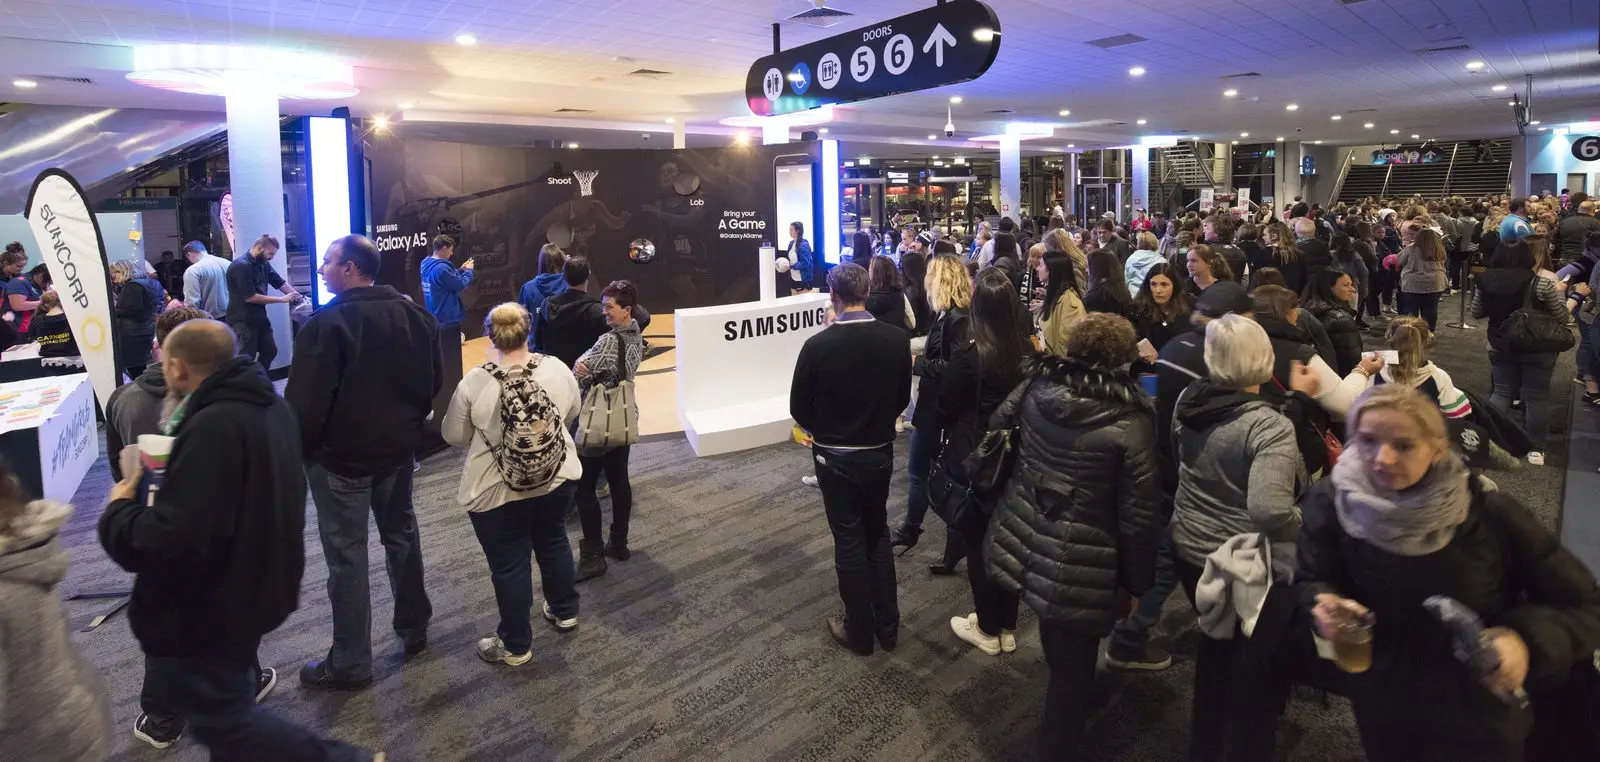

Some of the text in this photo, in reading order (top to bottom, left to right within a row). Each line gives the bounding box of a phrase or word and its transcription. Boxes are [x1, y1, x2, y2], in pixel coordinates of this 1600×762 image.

[863, 24, 892, 42] DOORS
[857, 39, 906, 76] 5 6
[1580, 138, 1599, 158] 6
[547, 177, 572, 185] Shoot
[723, 210, 740, 218] Bring
[376, 224, 398, 233] SAMSUNG
[718, 219, 766, 230] A Game
[376, 232, 428, 252] Galaxy A5
[40, 203, 89, 309] SUNCORP
[724, 307, 824, 342] SAMSUNG
